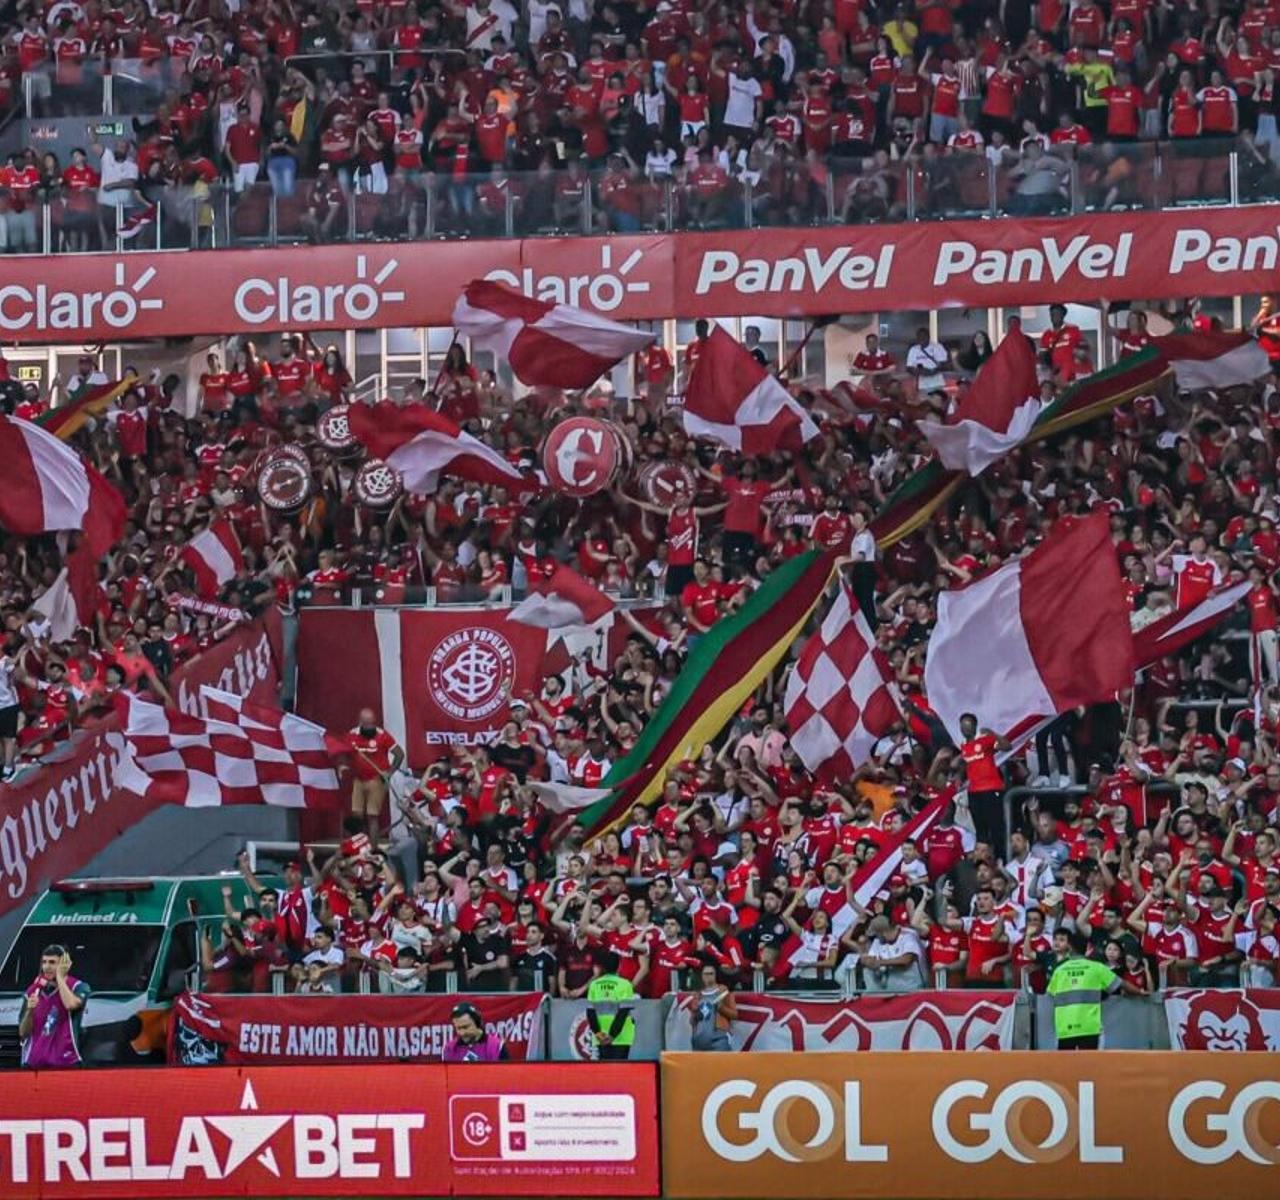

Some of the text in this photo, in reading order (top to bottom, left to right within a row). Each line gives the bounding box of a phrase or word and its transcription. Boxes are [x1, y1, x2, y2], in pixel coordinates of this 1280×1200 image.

[694, 244, 894, 295] PanVel
[933, 232, 1134, 287] PanVel
[234, 278, 378, 325] Claro
[484, 267, 624, 312] laro
[50, 911, 116, 924] Unimed
[240, 1023, 281, 1053] ESTE
[286, 1025, 338, 1056] AMOR
[343, 1023, 379, 1057] NÃO
[701, 1079, 888, 1164] GOL
[932, 1079, 1124, 1165] GOL
